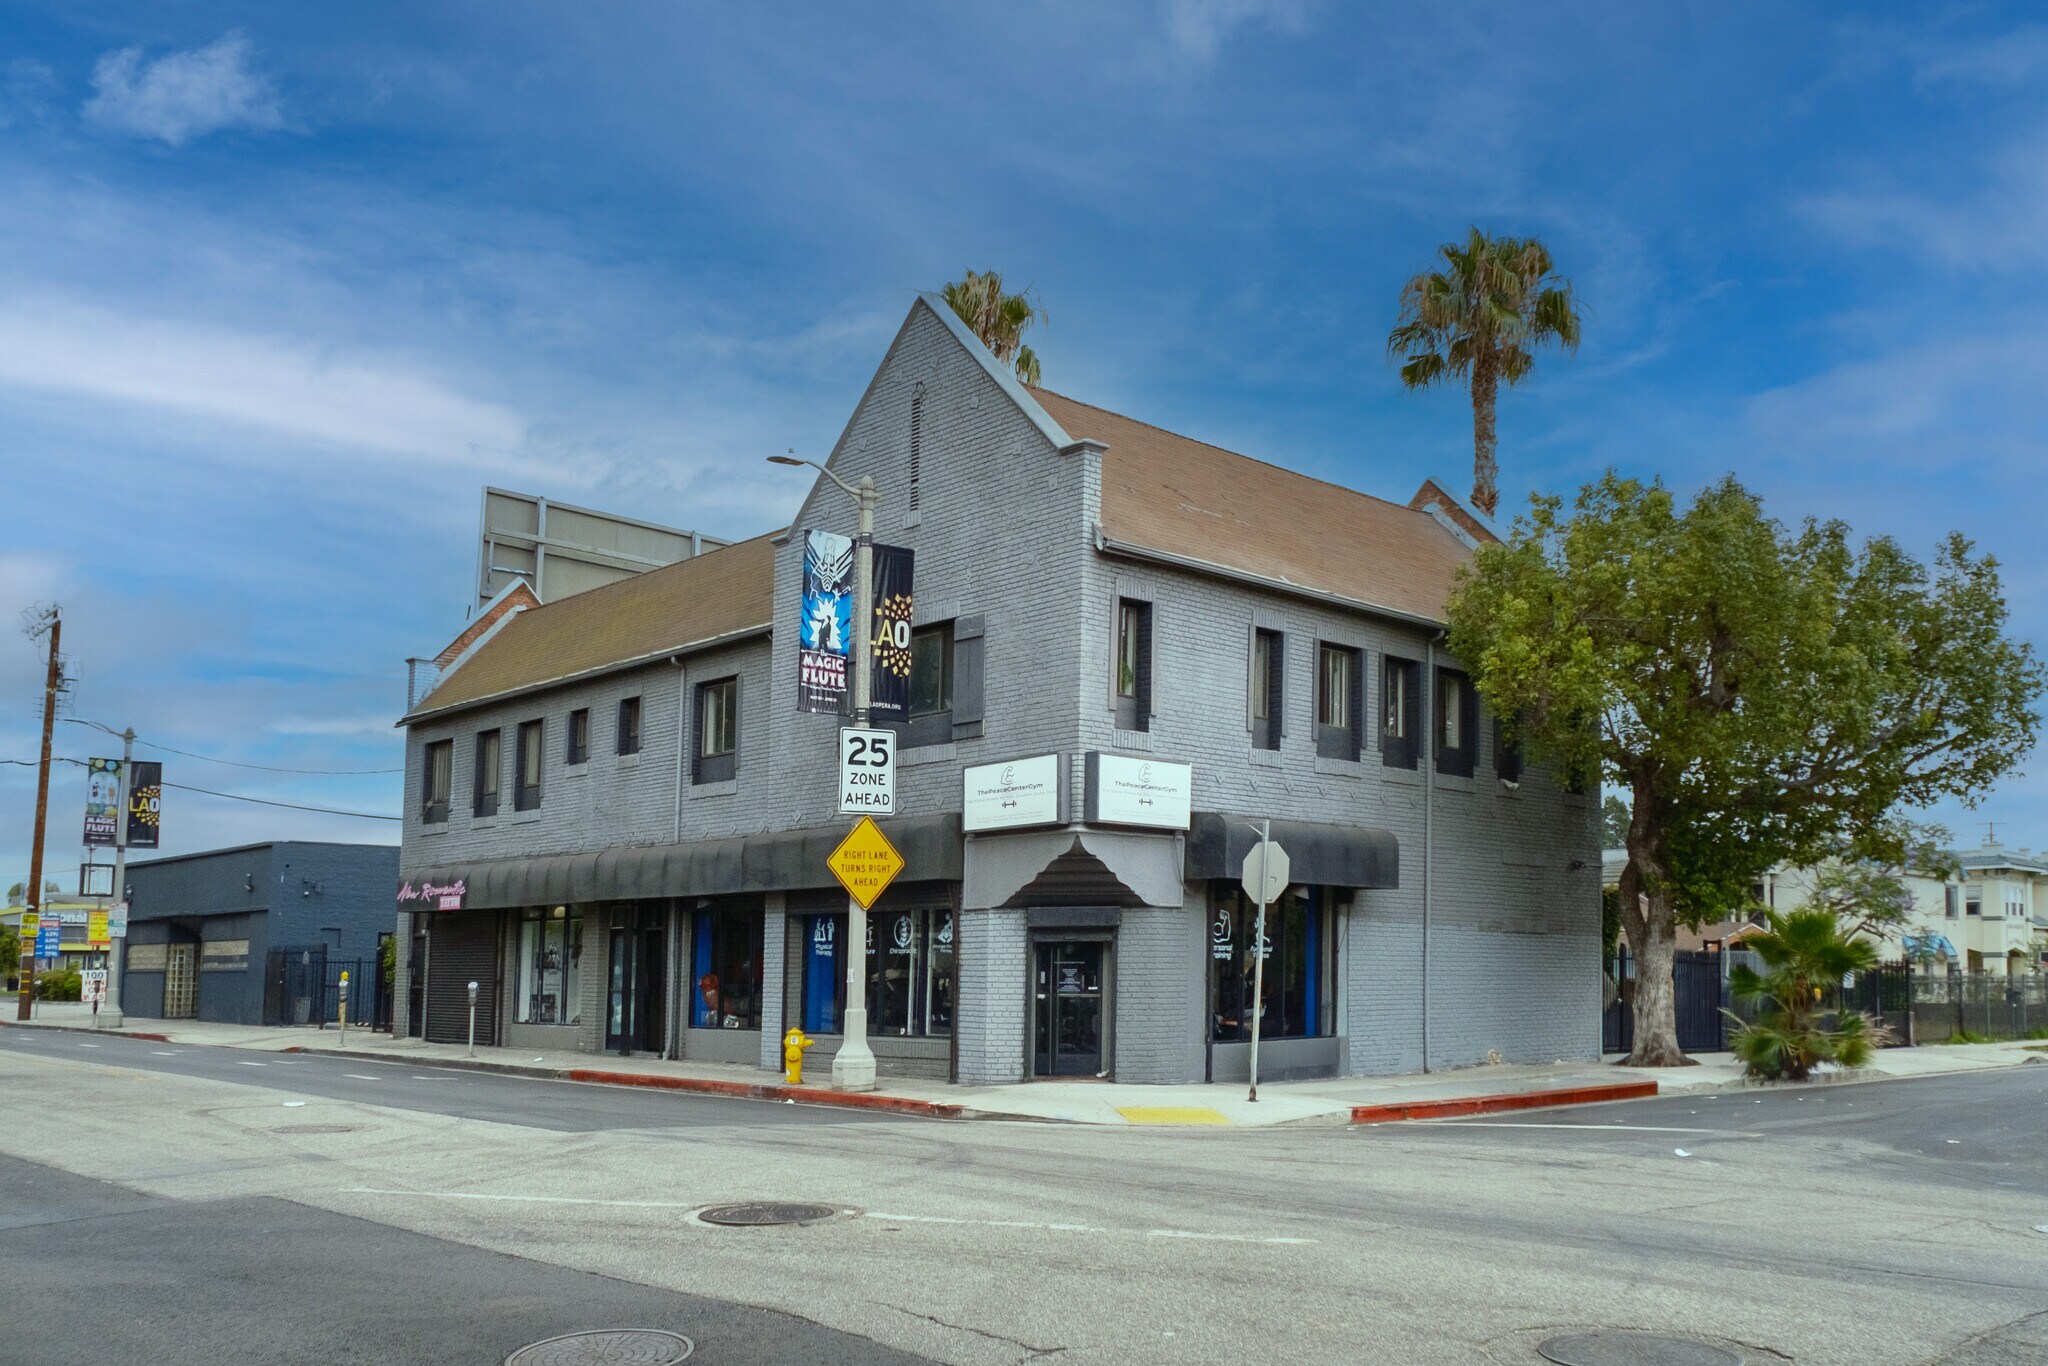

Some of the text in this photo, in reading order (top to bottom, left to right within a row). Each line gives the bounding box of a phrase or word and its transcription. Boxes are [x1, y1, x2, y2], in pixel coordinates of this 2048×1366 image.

[870, 619, 910, 649] AO
[802, 653, 845, 672] MAGIC
[802, 667, 846, 688] FLUTE
[848, 736, 889, 767] 25
[850, 772, 886, 786] ZONE
[977, 783, 1044, 796] ThePeaceCenterGym
[1115, 781, 1178, 793] ThePeaceCenterGym
[129, 797, 160, 813] LAO
[844, 792, 890, 806] AHEAD
[86, 824, 116, 832] FLUTE
[843, 850, 888, 860] RIGHT LANE
[841, 864, 890, 873] TURNS RIGHT
[853, 878, 879, 887] AHEAD
[397, 880, 466, 902] New Romantic
